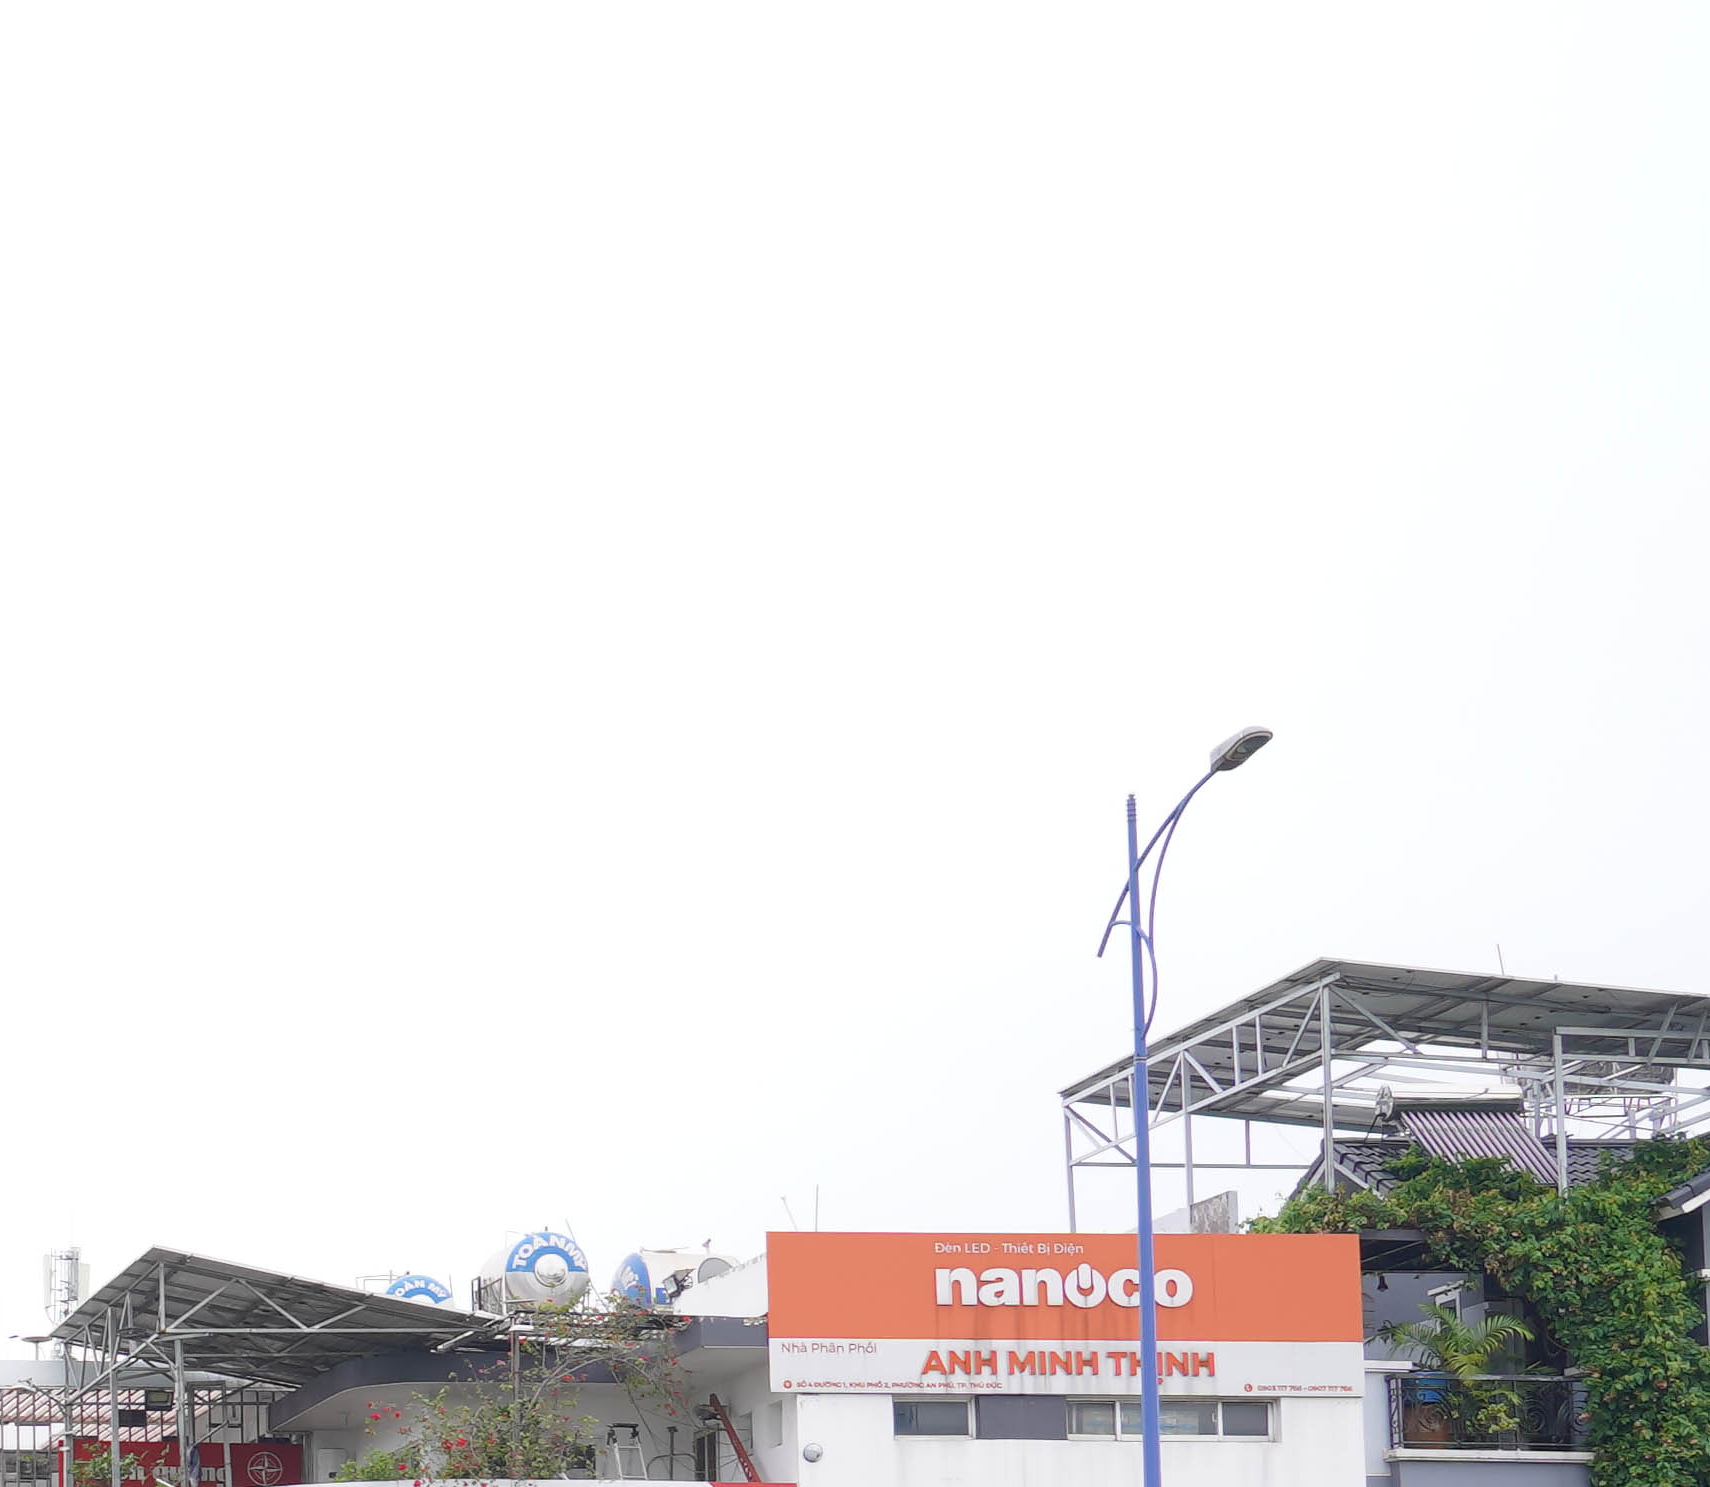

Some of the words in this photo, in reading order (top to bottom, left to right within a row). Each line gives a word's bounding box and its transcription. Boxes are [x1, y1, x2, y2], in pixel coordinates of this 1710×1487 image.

[934, 1241, 961, 1254] Đèn
[965, 1243, 990, 1254] LED
[1002, 1241, 1033, 1254] Thiết
[1038, 1243, 1050, 1256] Bị
[1054, 1242, 1084, 1256] Điện
[935, 1263, 1193, 1308] nanoco
[781, 1342, 808, 1353] Nhà
[811, 1342, 844, 1354] Phân
[849, 1341, 877, 1354] Phối
[921, 1350, 997, 1376] ANH
[1007, 1350, 1099, 1376] MINH
